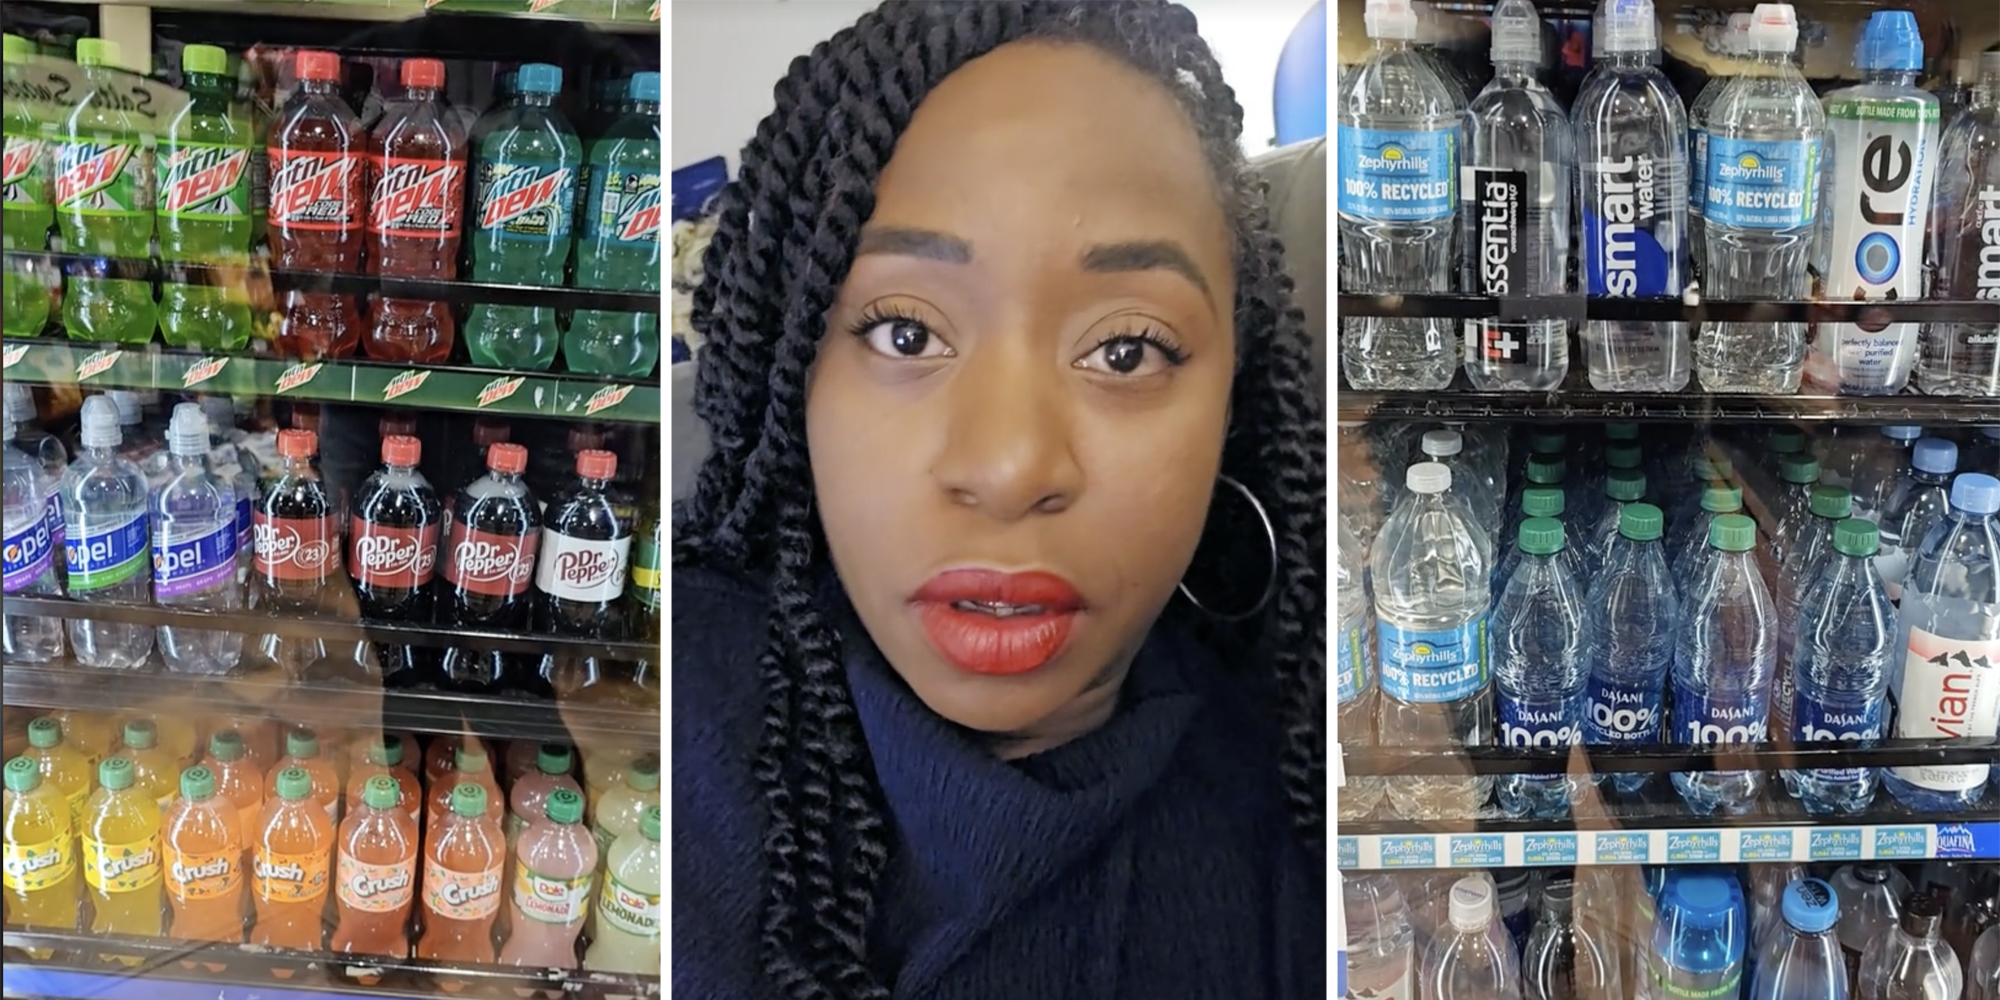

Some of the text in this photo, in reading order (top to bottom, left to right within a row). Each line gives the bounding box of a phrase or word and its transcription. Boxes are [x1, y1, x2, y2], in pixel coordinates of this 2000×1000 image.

[1856, 104, 1876, 117] BOTTLE
[1876, 106, 1895, 118] MADE
[1896, 107, 1916, 119] FROM
[1358, 155, 1430, 172] Zephyrhills
[1719, 163, 1785, 180] Zephyrhills
[1345, 178, 1448, 200] 100% RECYCLED
[1635, 153, 1654, 220] water
[1908, 139, 1925, 227] HYDRATION
[1709, 187, 1803, 209] 100% RECYCLED
[305, 207, 338, 217] RED
[406, 214, 439, 224] RED
[1597, 155, 1637, 298] smart
[1482, 181, 1508, 297] ssentia
[1967, 333, 2000, 344] alkalin
[1865, 349, 1893, 357] purified
[254, 524, 296, 559] Pepper
[261, 524, 280, 541] Dr
[356, 536, 416, 570] Pepper
[375, 536, 400, 553] Dr
[476, 541, 501, 560] Dr
[305, 548, 319, 562] 23
[455, 541, 515, 576] Pepper
[579, 549, 603, 567] Dr
[1393, 647, 1457, 665] Zephyrhills
[1413, 664, 1479, 687] RECYCLED
[1601, 687, 1644, 704] DASANI
[1587, 697, 1659, 732] 100%
[1711, 706, 1754, 722] DASANI
[1931, 673, 1972, 738] vian
[1517, 710, 1563, 725] DASANI
[1824, 713, 1867, 727] DASANI
[1501, 721, 1583, 746] 100%
[1688, 716, 1768, 744] 100%
[1452, 839, 1502, 854] Zephyrhills
[1525, 838, 1576, 853] Zephyrhills
[1598, 837, 1647, 851] Zephyrhills
[1669, 835, 1719, 850] Zephyrhills
[1741, 834, 1791, 849] Zephyrhills
[1811, 833, 1860, 847] Zephyrhills
[1877, 831, 1925, 847] Zephyrhills
[1936, 834, 1976, 852] QUAFINA
[1382, 841, 1433, 856] Zephyrhills
[3, 848, 61, 879] Crush
[99, 847, 154, 879] Crush
[172, 857, 230, 883] Crush
[352, 869, 411, 897] Crush
[442, 875, 499, 906] Crush
[526, 896, 571, 916] LEMONAD
